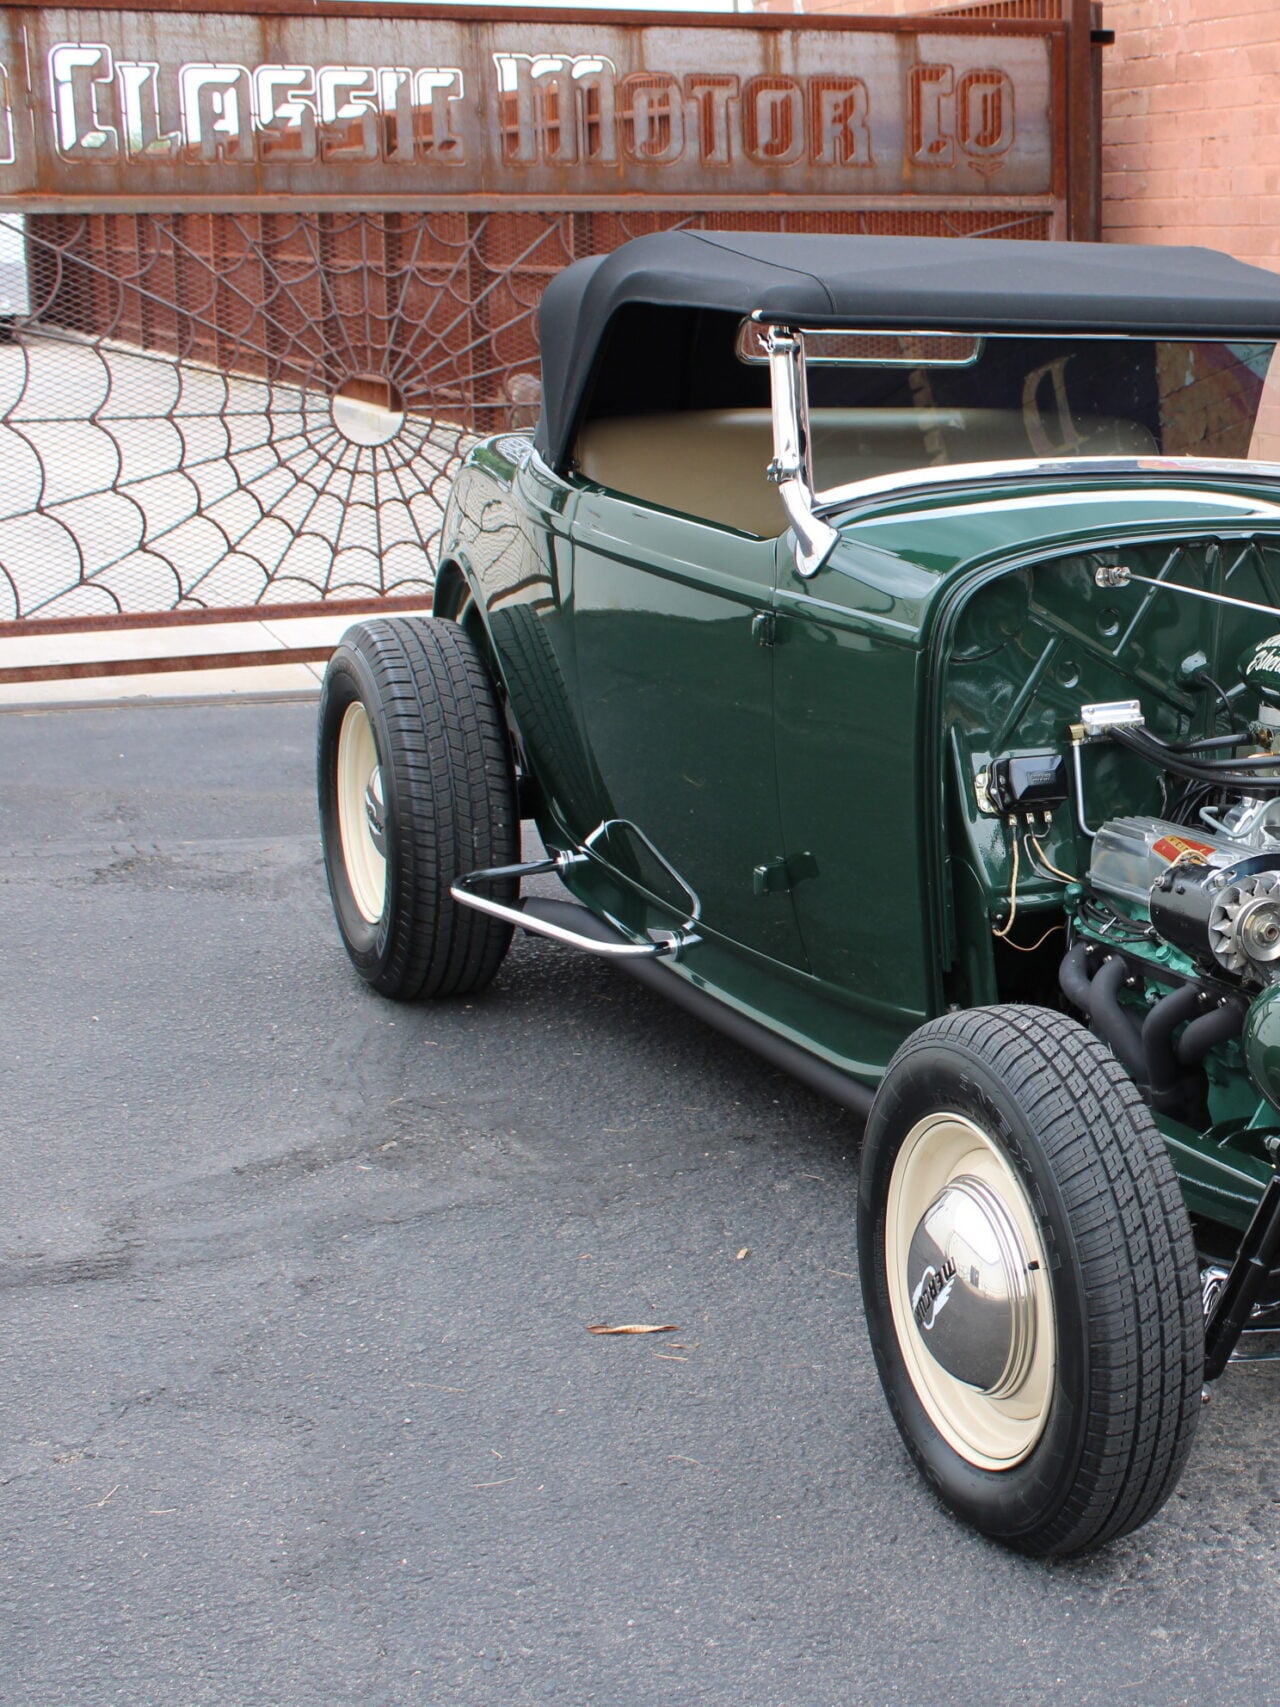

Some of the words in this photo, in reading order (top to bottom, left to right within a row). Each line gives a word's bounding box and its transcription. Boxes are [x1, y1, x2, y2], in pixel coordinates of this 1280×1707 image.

[48, 42, 466, 166] CLASSIC
[491, 52, 875, 169] MOTOR
[905, 62, 1016, 169] CO
